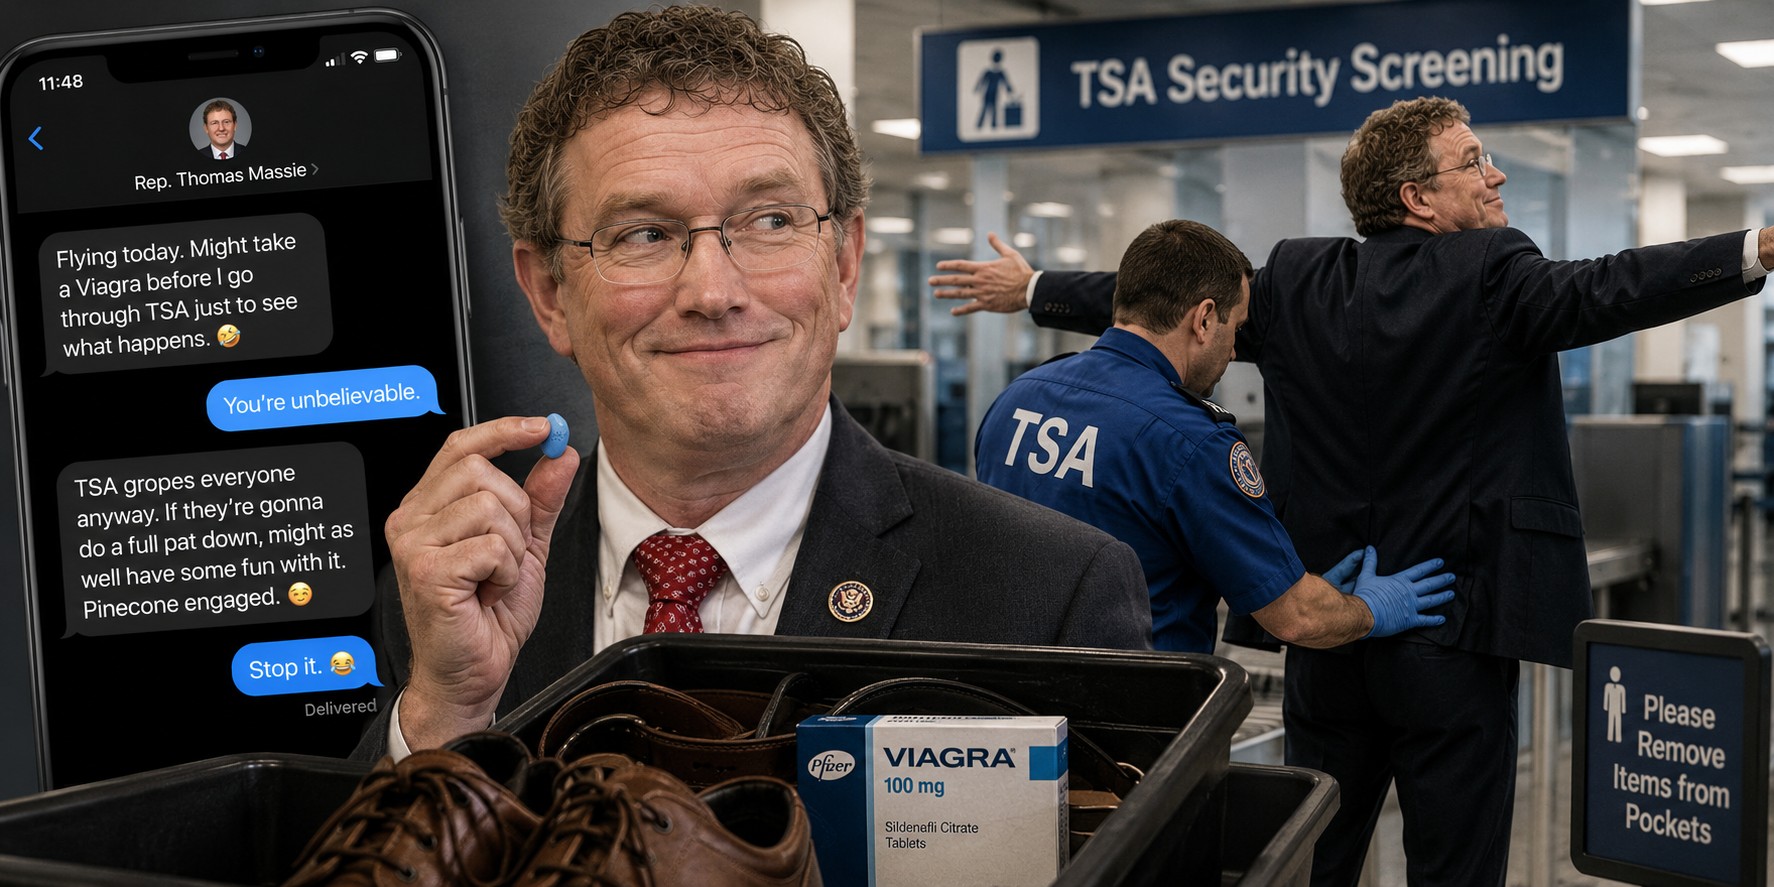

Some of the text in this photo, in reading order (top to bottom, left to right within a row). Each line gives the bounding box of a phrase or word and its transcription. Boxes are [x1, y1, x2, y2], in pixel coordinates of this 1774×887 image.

[38, 74, 84, 91] 11:48
[1072, 35, 1564, 108] TSA Security Screening
[134, 162, 307, 192] Rep. Thomas Massie
[56, 232, 296, 272] Flying today. Might take
[59, 267, 254, 299] a Viagra before I go
[60, 295, 298, 328] through TSA just to see
[62, 333, 211, 358] what happens.
[223, 382, 420, 415] You’re unbelievable.
[1004, 407, 1099, 488] TSA
[73, 467, 296, 499] TSA gropes everyone
[77, 495, 324, 531] anyway. If they’re gonna
[79, 522, 354, 559] do a full pat down, might as
[80, 550, 346, 589] well have some fun with it.
[83, 586, 281, 620] Pinecone engaged.
[249, 656, 322, 681] Stop it.
[304, 697, 377, 717] Delivered
[1644, 693, 1716, 730] Please
[1637, 730, 1726, 769] Remove
[810, 753, 853, 782] Pfizer
[883, 776, 945, 798] 100 mg
[1613, 763, 1731, 809] Items from
[940, 821, 979, 834] Citrate
[1625, 802, 1713, 844] Pockets
[885, 836, 927, 849] Tablets
